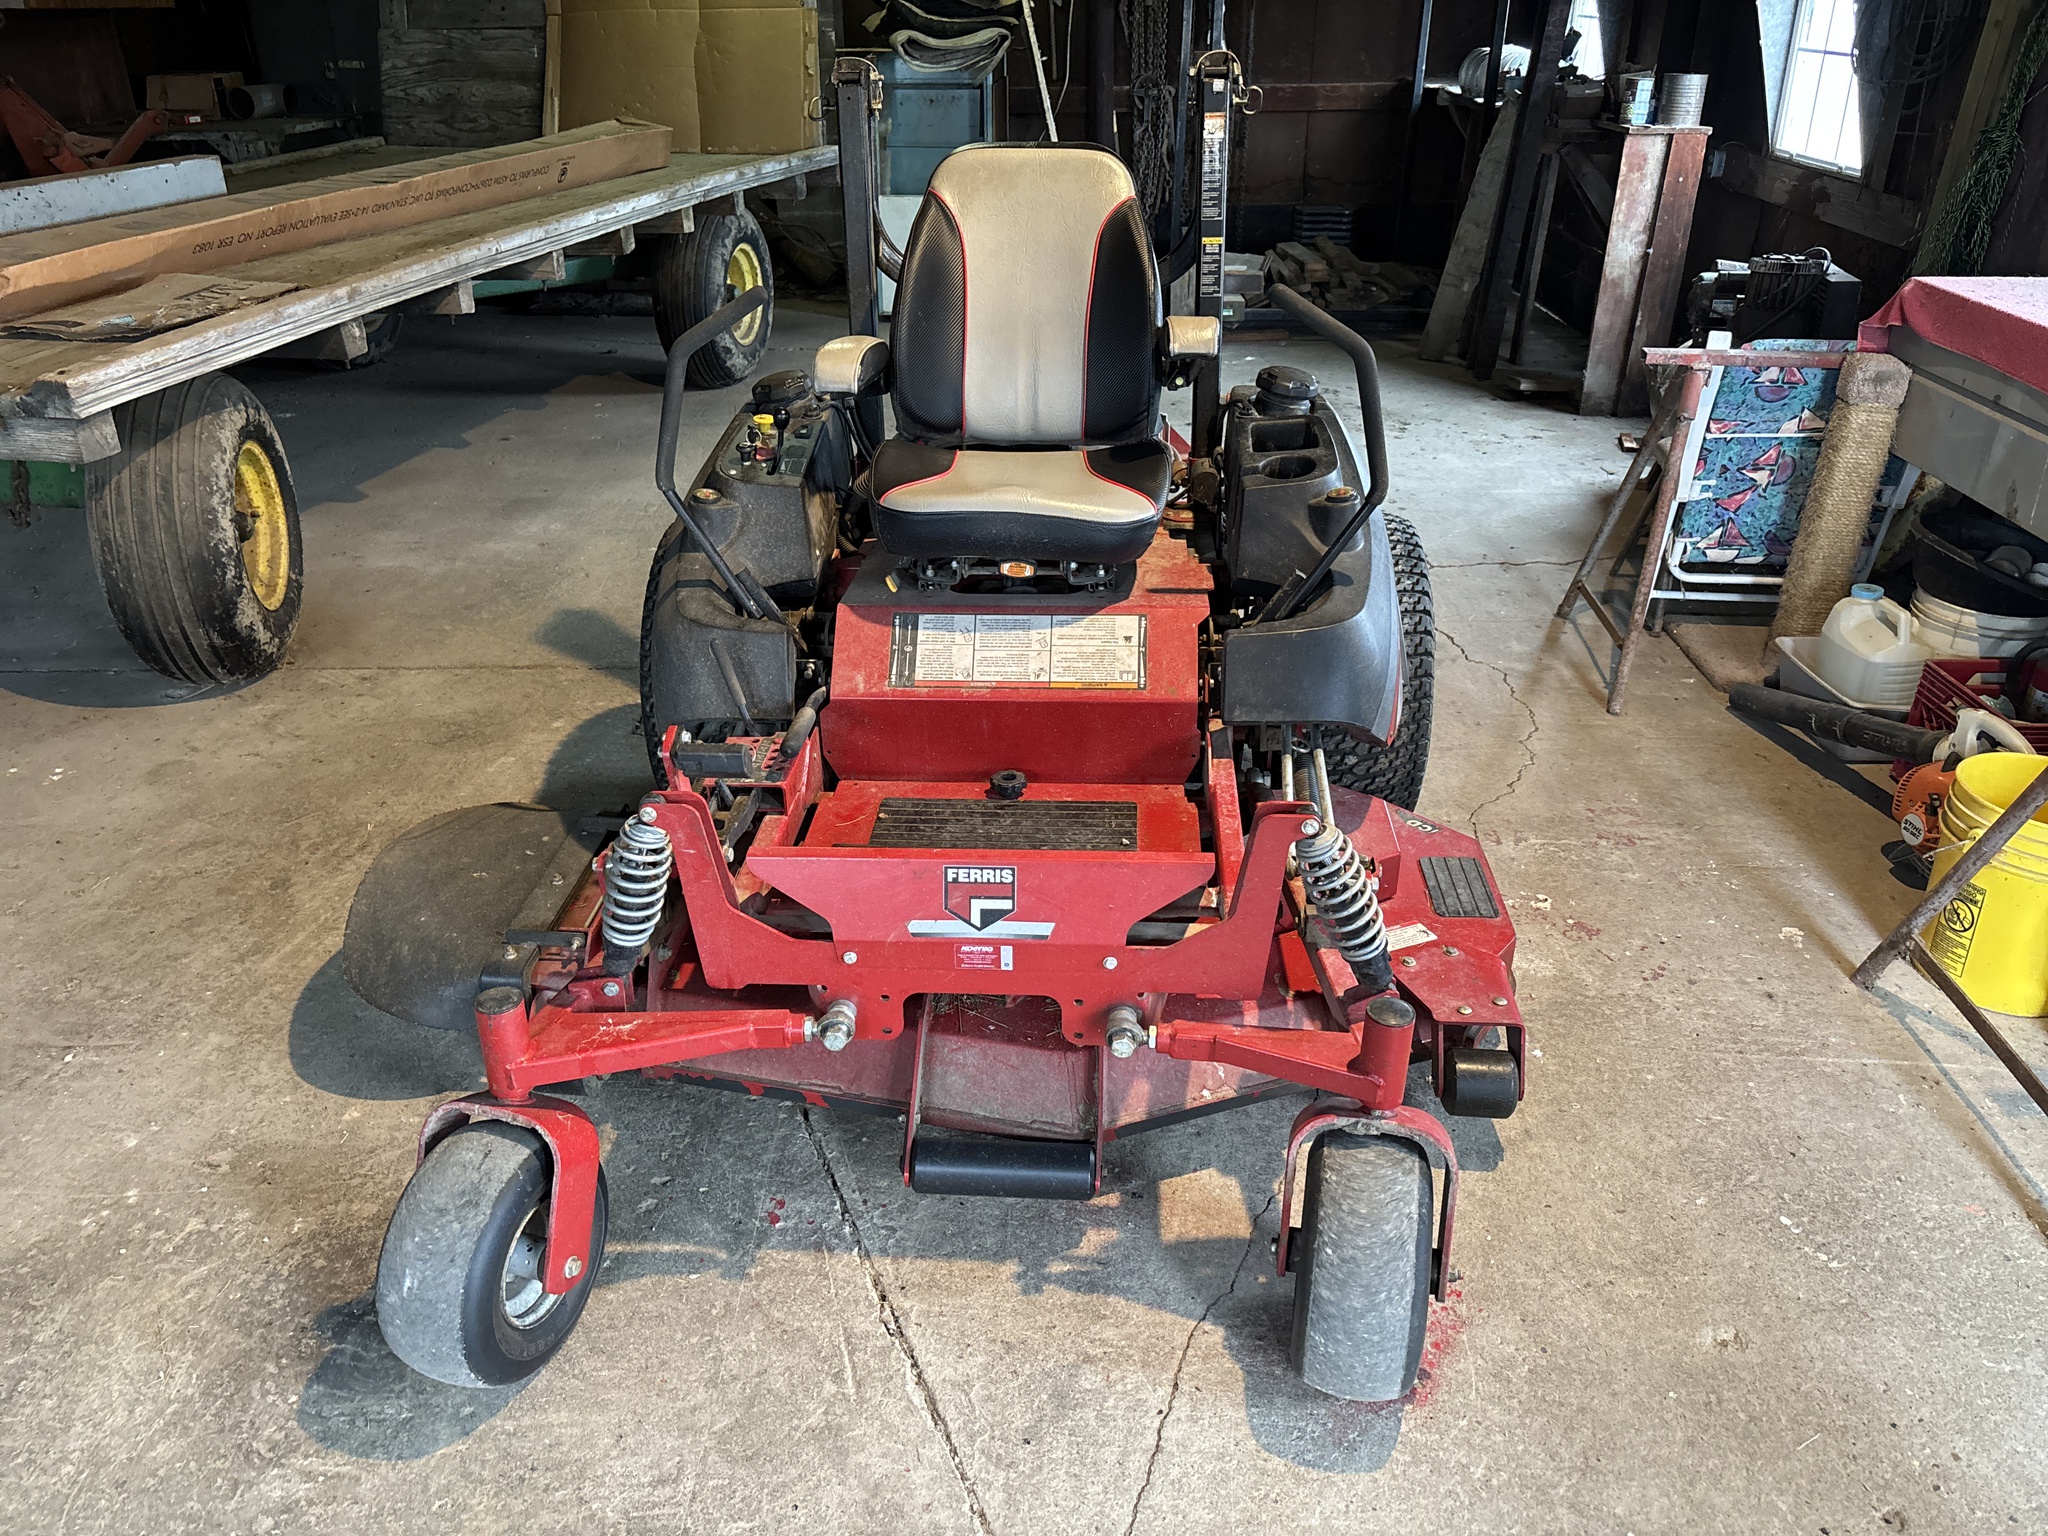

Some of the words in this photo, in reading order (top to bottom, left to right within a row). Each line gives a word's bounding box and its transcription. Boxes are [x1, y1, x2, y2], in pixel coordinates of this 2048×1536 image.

[509, 173, 519, 183] TO
[424, 191, 434, 202] TO
[371, 198, 407, 213] STANDARD
[290, 213, 337, 231] EVALUATION
[237, 232, 253, 243] NO.
[255, 226, 288, 240] REPORT
[192, 240, 214, 254] 1083
[217, 238, 234, 248] ESR
[1903, 818, 1922, 836] STIHL
[947, 868, 1014, 883] FERRIS
